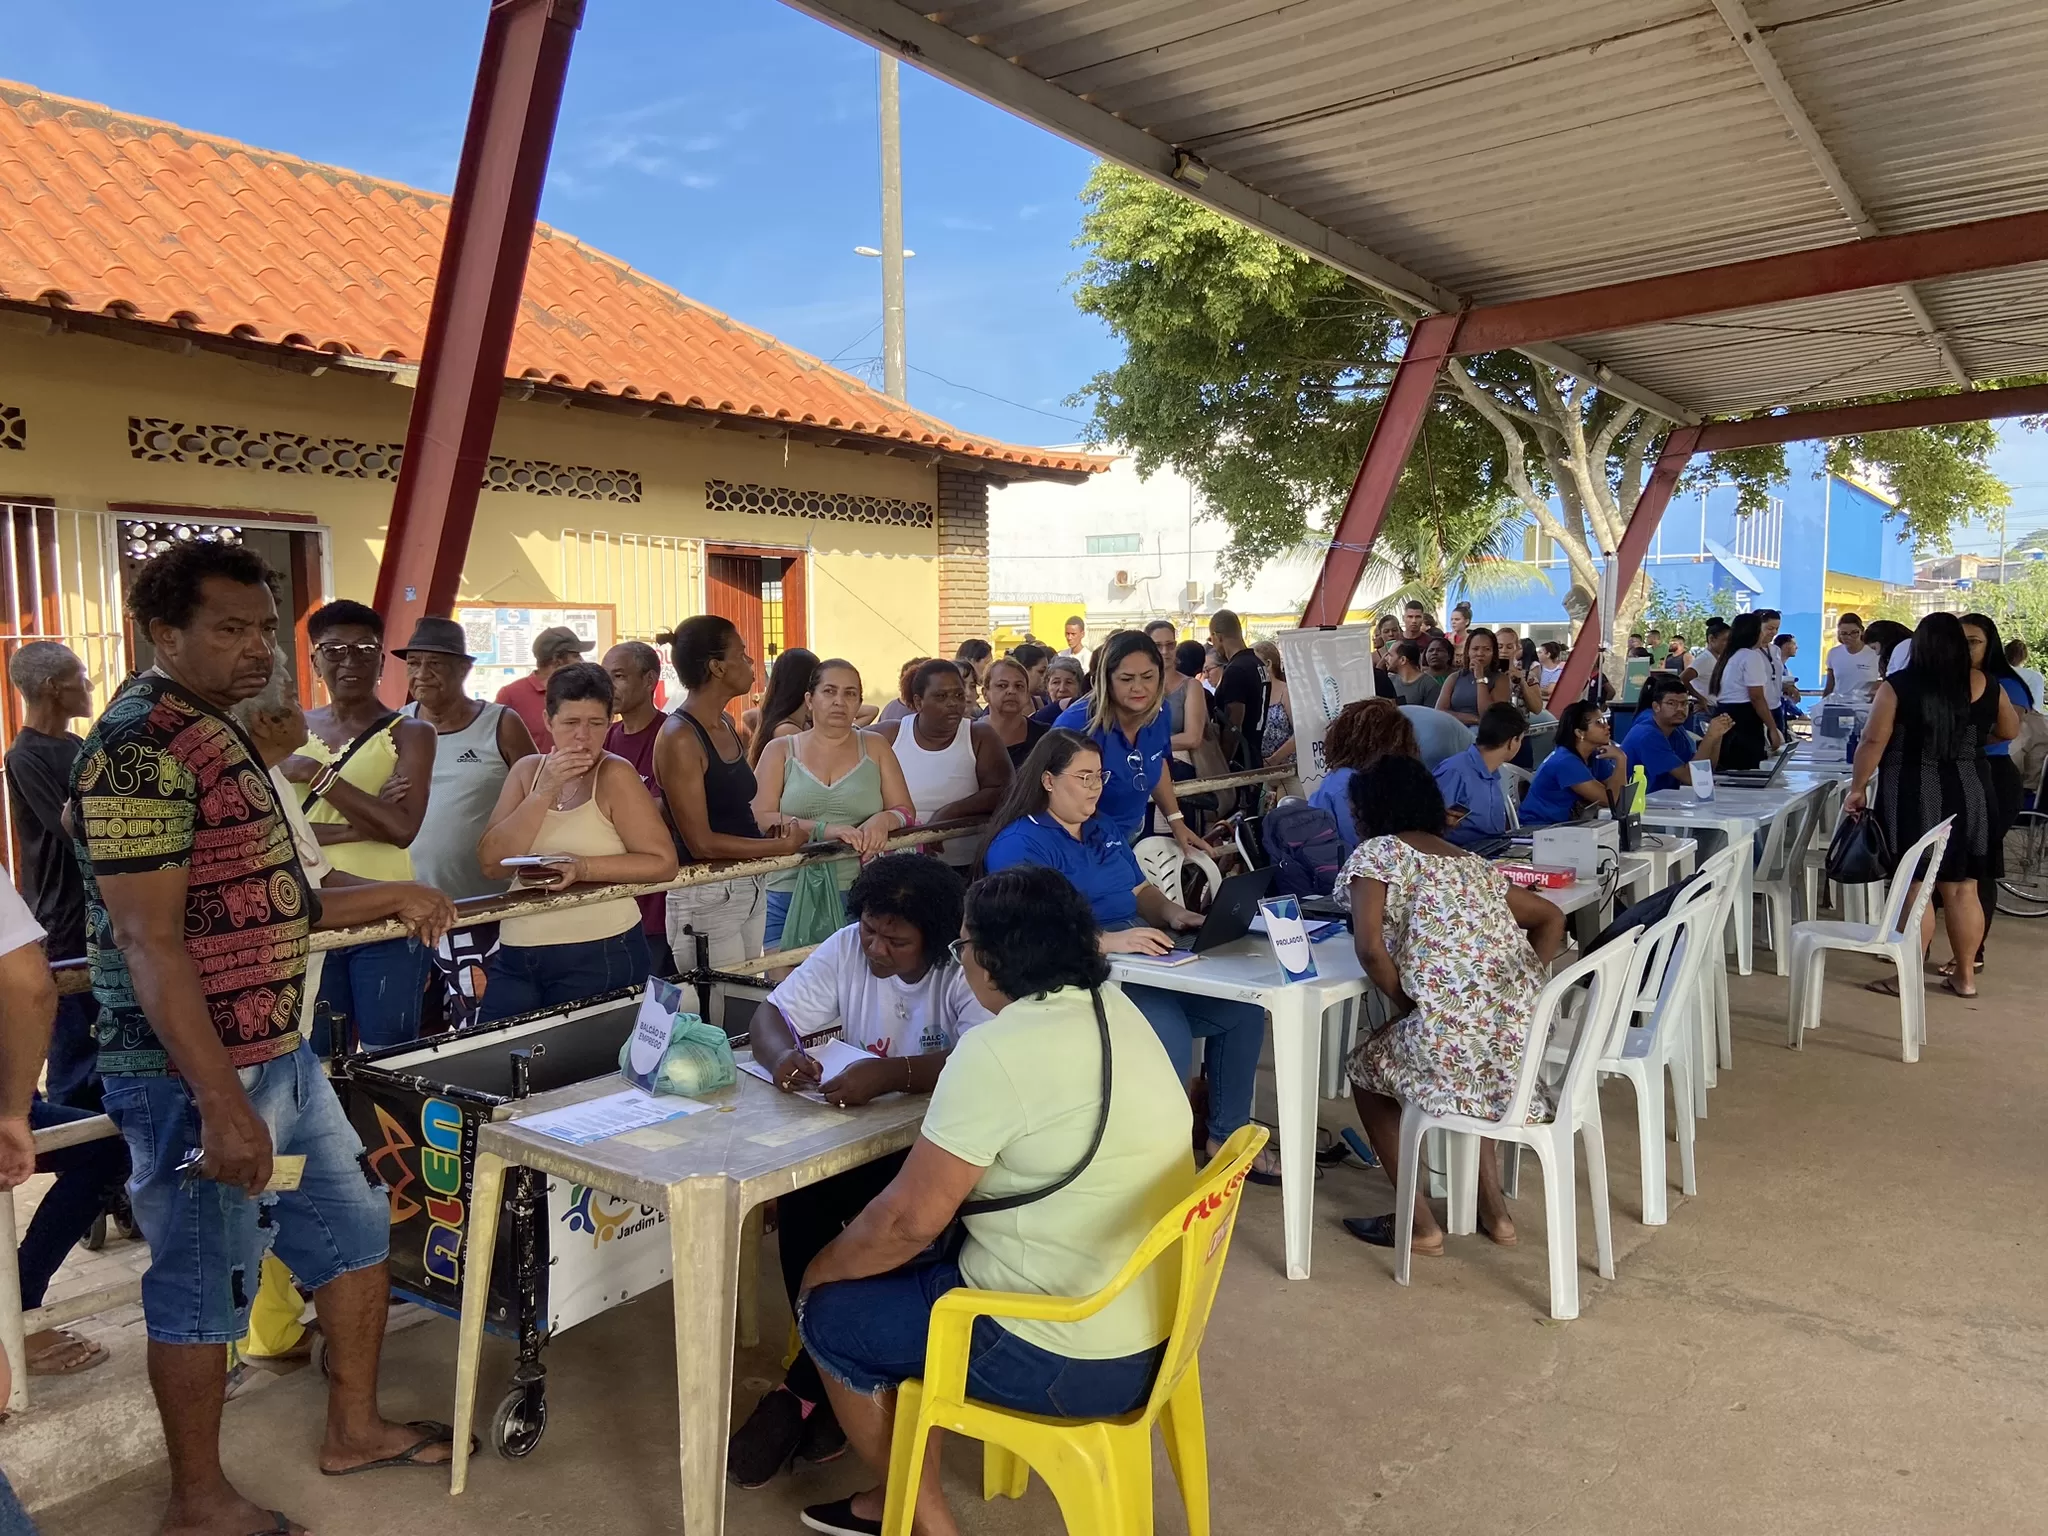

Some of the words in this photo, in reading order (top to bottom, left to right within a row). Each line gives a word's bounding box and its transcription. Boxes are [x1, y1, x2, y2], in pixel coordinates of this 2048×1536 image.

[1275, 936, 1303, 946] PROLAGOS
[640, 1022, 658, 1037] BALCÃO
[659, 1031, 666, 1040] DE
[921, 1032, 945, 1042] BALC
[638, 1032, 662, 1049] EMPREGO
[463, 1112, 475, 1165] Visual
[617, 1217, 655, 1240] Jardim
